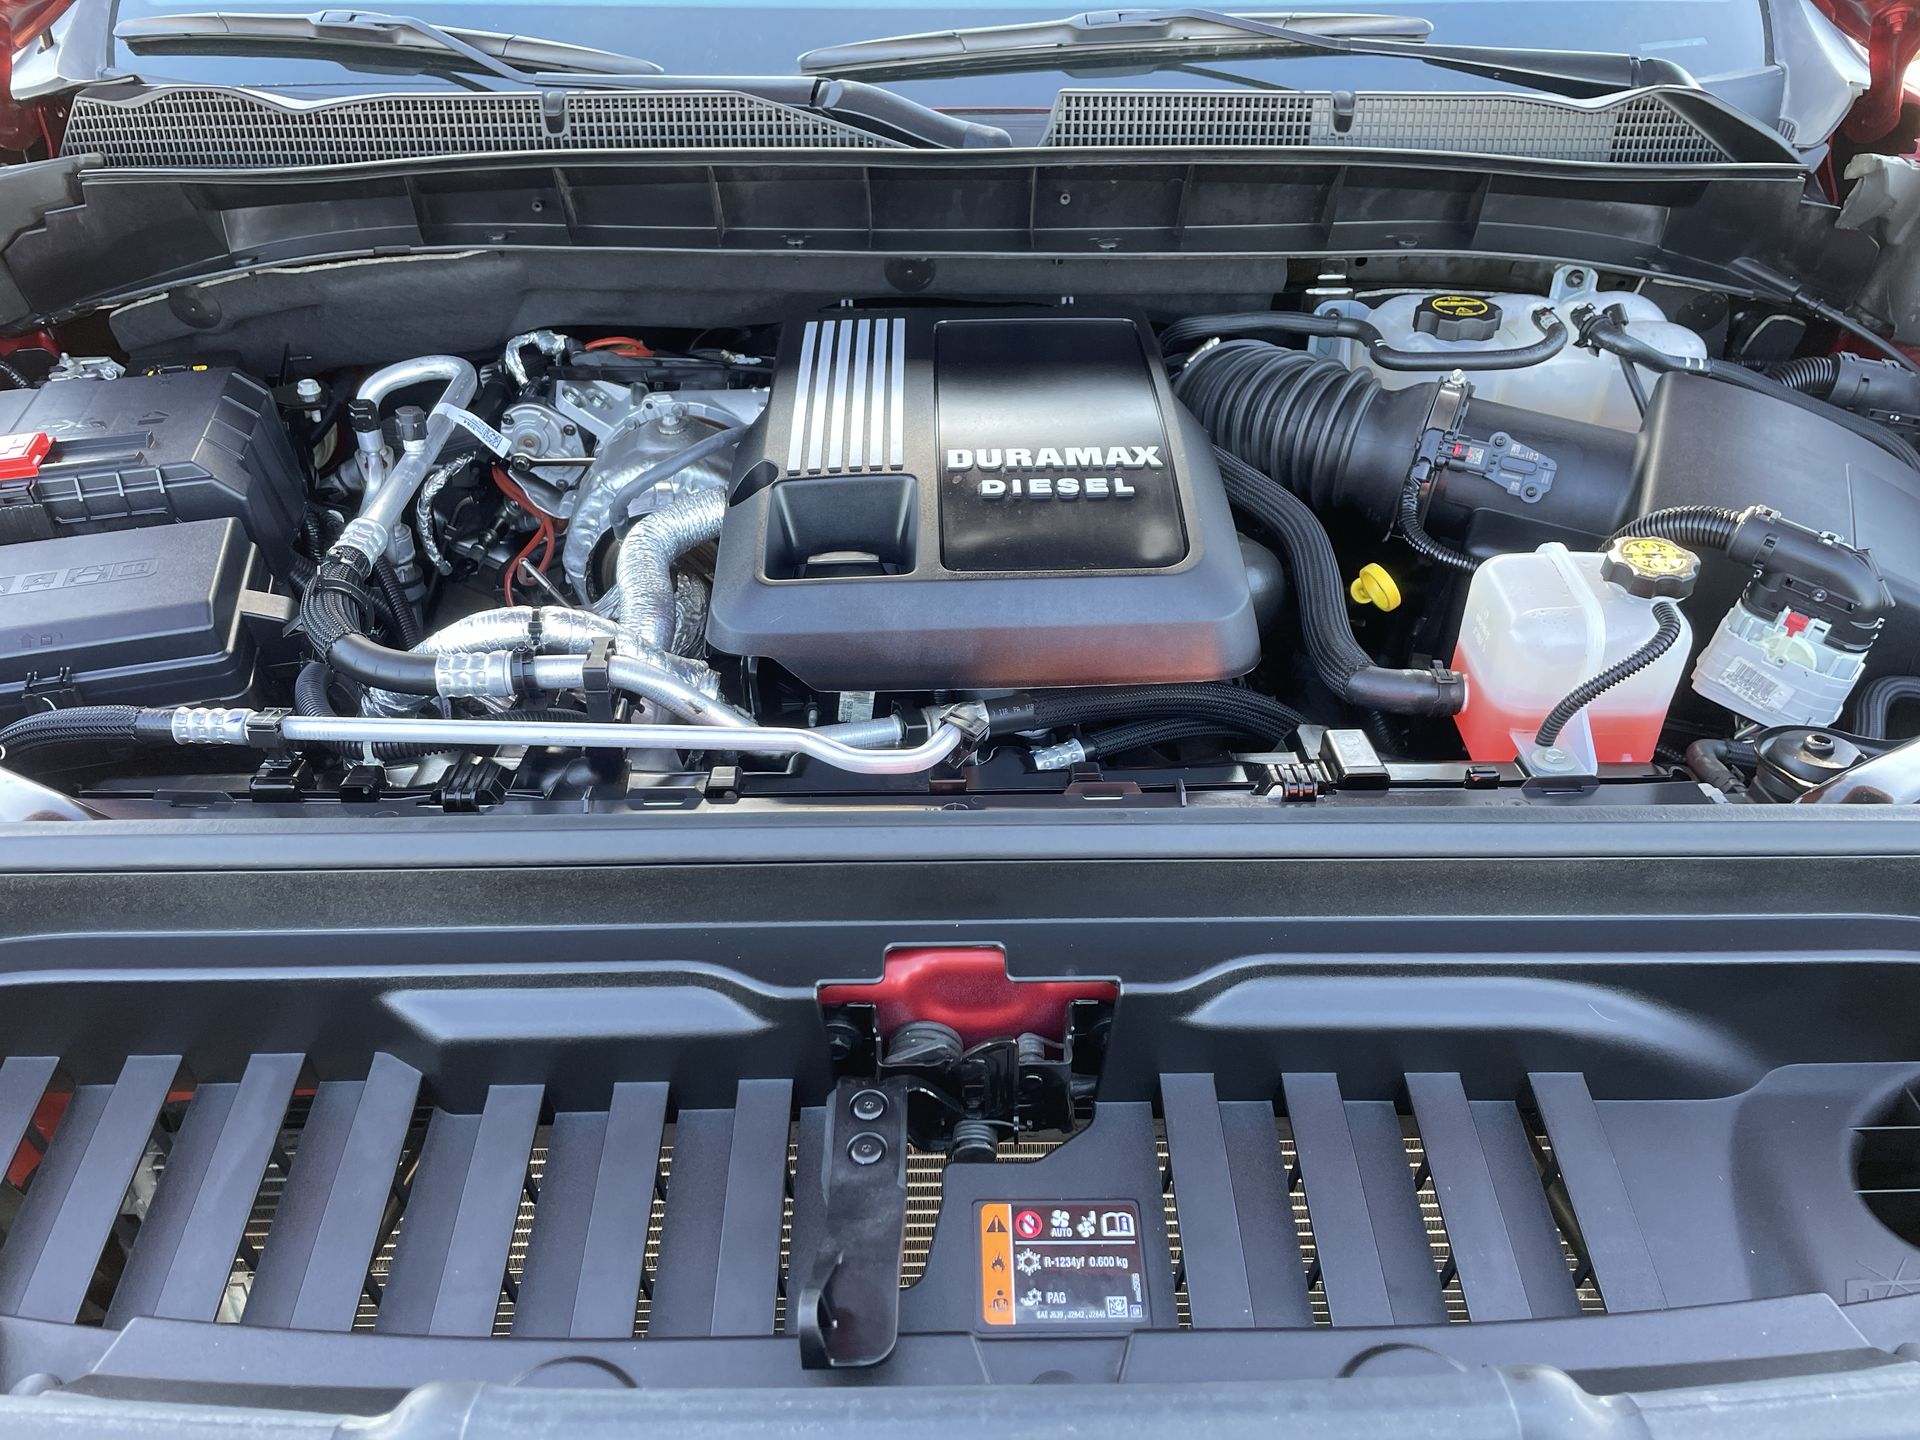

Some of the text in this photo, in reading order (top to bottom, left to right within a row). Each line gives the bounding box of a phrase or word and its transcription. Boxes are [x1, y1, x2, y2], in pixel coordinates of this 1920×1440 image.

[947, 446, 1163, 471] DURAMAX
[980, 478, 1135, 499] DIESEL
[1051, 1228, 1073, 1238] AUTO
[1044, 1256, 1129, 1269] R-1234yf 0.600 kg
[1047, 1292, 1067, 1303] PAG
